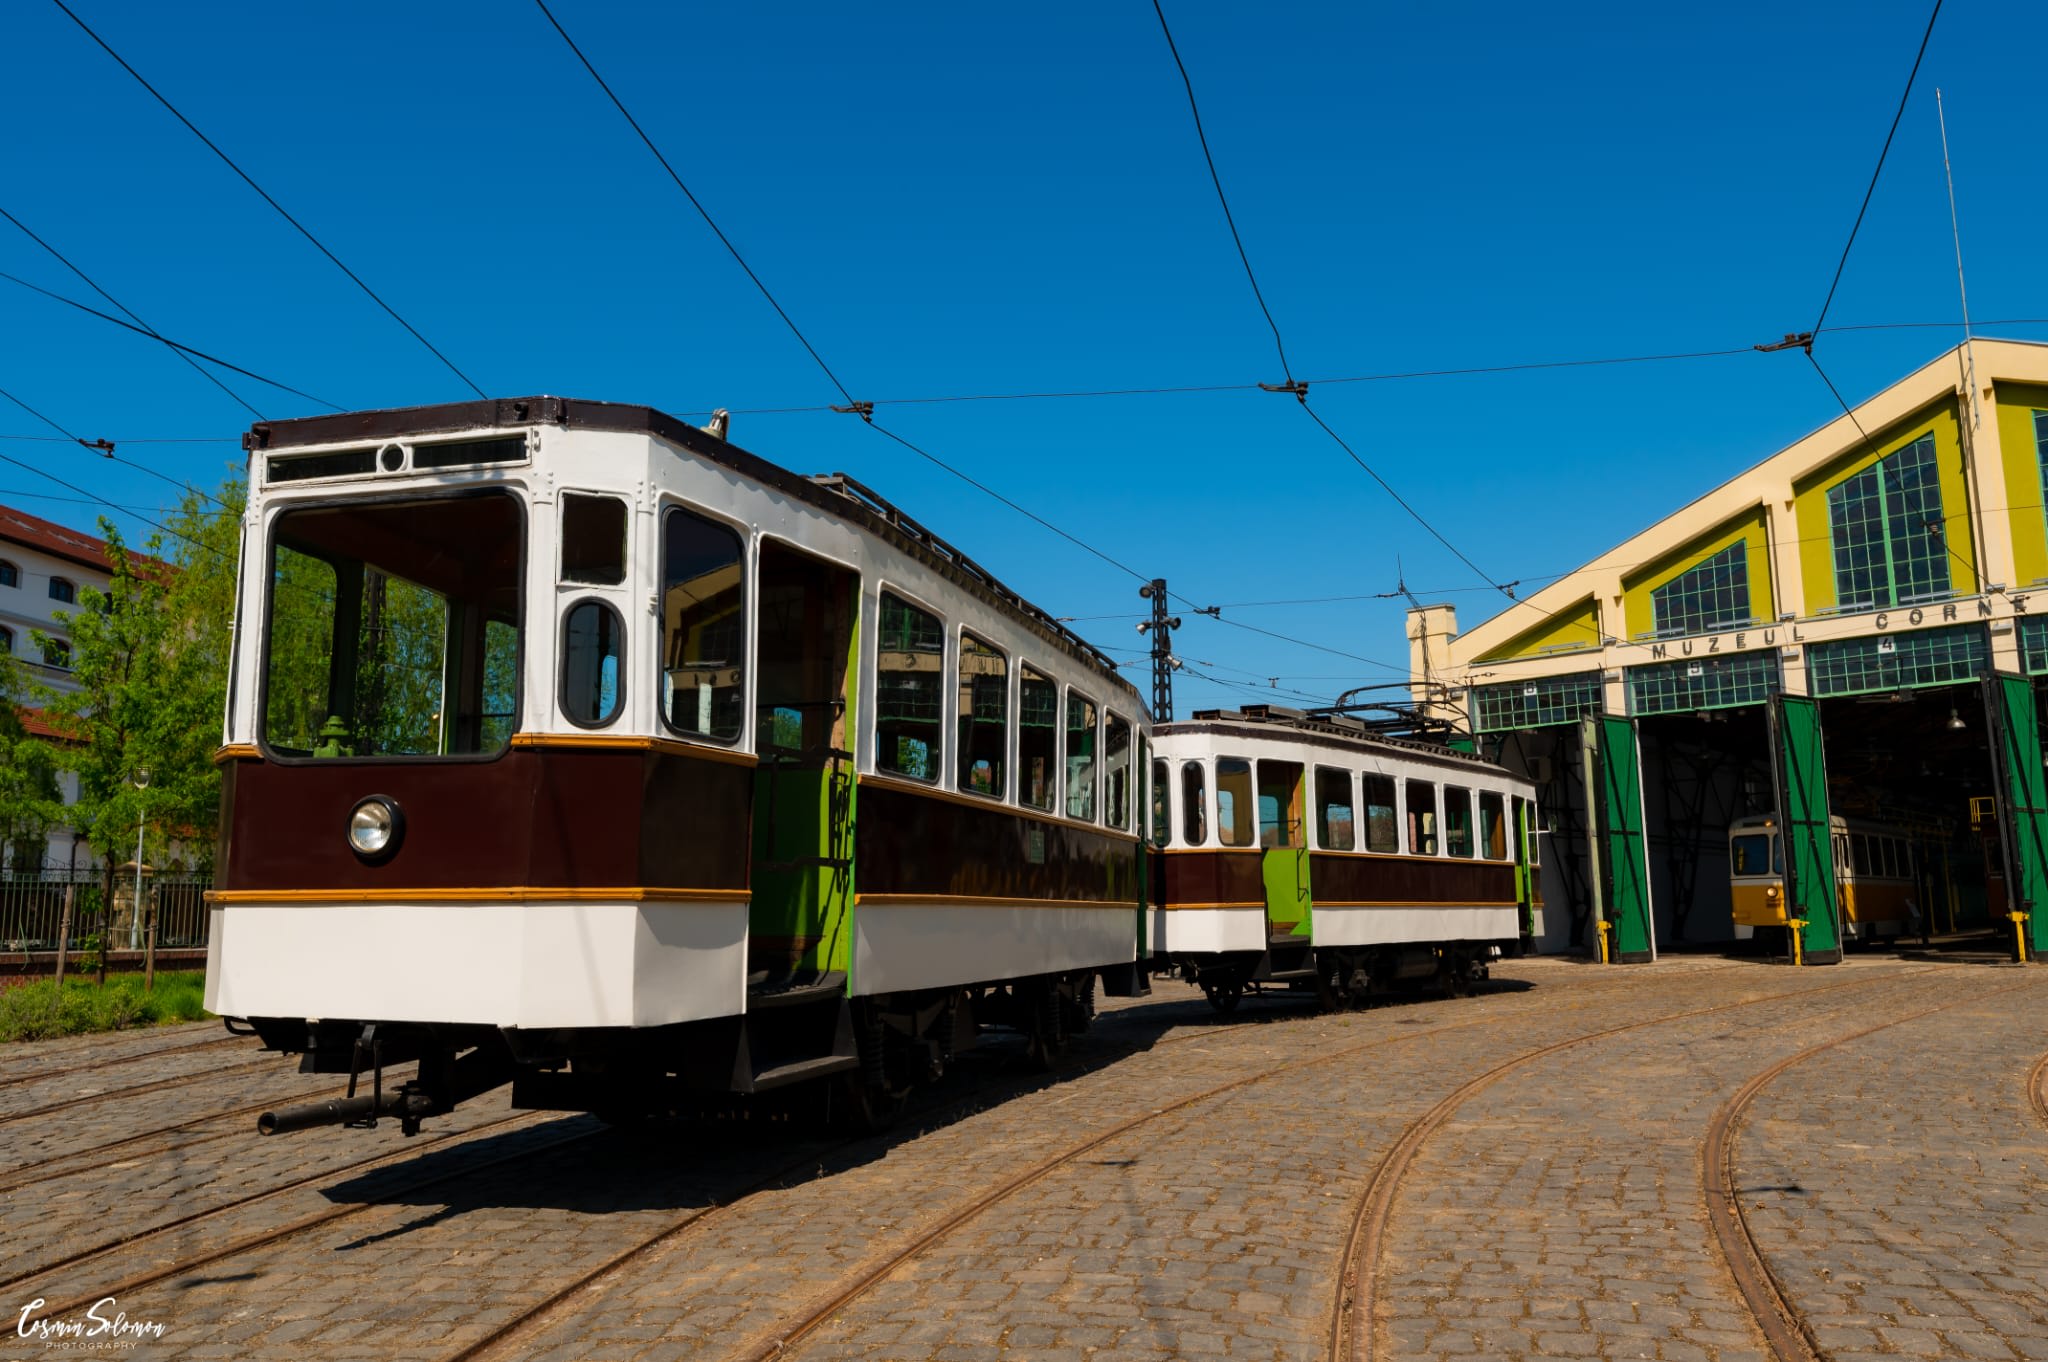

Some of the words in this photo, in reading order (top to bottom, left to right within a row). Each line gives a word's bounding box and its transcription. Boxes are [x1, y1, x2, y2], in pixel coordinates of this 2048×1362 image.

[1652, 625, 1805, 660] MUZEUL
[1875, 594, 2027, 630] CORNE
[1881, 637, 1893, 650] 4
